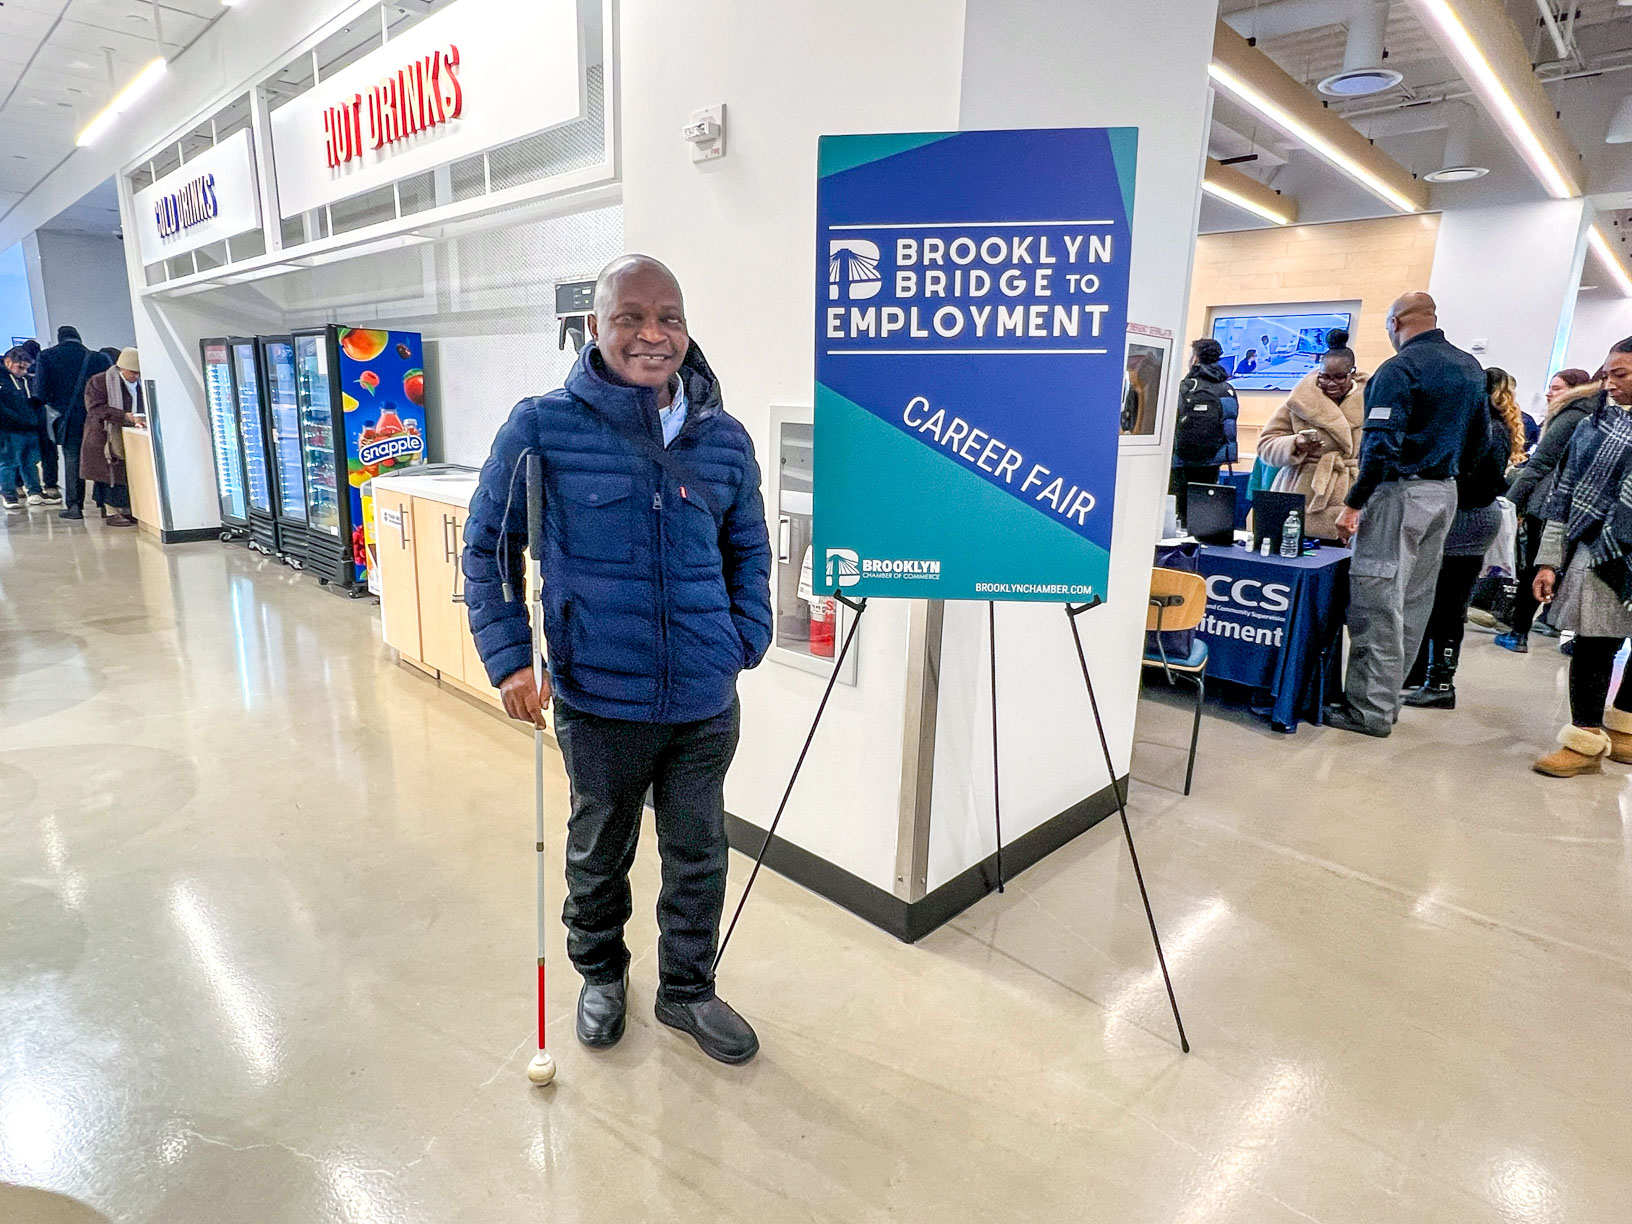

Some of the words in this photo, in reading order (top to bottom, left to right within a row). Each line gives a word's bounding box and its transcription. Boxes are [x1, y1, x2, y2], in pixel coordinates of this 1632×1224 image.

[323, 93, 362, 168] HOT
[364, 43, 462, 149] DRINKS
[896, 234, 1112, 266] BROOKLYN
[895, 268, 1052, 298] BRIDGE
[1066, 274, 1100, 294] TO
[827, 304, 1109, 338] EMPLOYMENT
[363, 436, 420, 461] snapple
[903, 396, 1023, 484] CAREER
[1020, 464, 1096, 526] FAIR
[862, 560, 941, 574] BROOKLYN
[975, 583, 1092, 594] BROOKLYNCHAMBER.COM
[1217, 605, 1250, 617] Community
[1251, 612, 1286, 622] Supervision
[1195, 613, 1283, 647] itment
